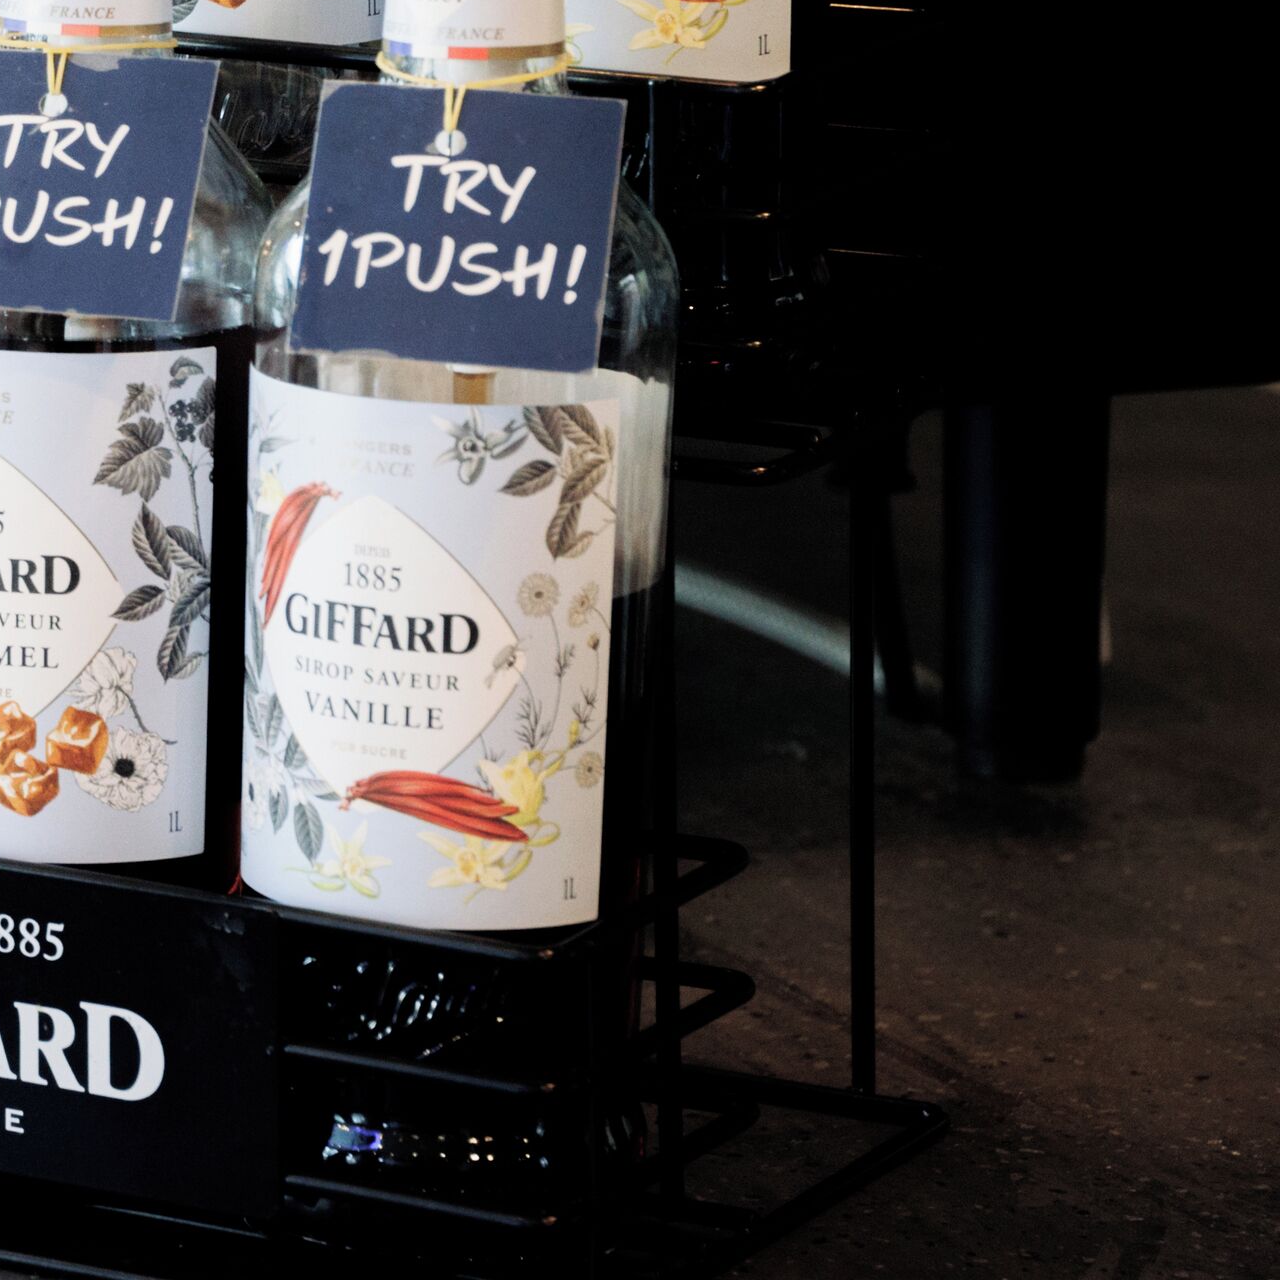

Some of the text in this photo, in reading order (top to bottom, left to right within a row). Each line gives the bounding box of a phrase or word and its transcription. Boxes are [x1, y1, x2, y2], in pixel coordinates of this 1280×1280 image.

[391, 154, 536, 224] TRY
[318, 229, 587, 305] 1PUSH!
[344, 563, 403, 592] 1885
[285, 592, 480, 655] GIFFARD
[296, 656, 460, 691] SIROP SAVEUR
[304, 690, 444, 730] VANILLE
